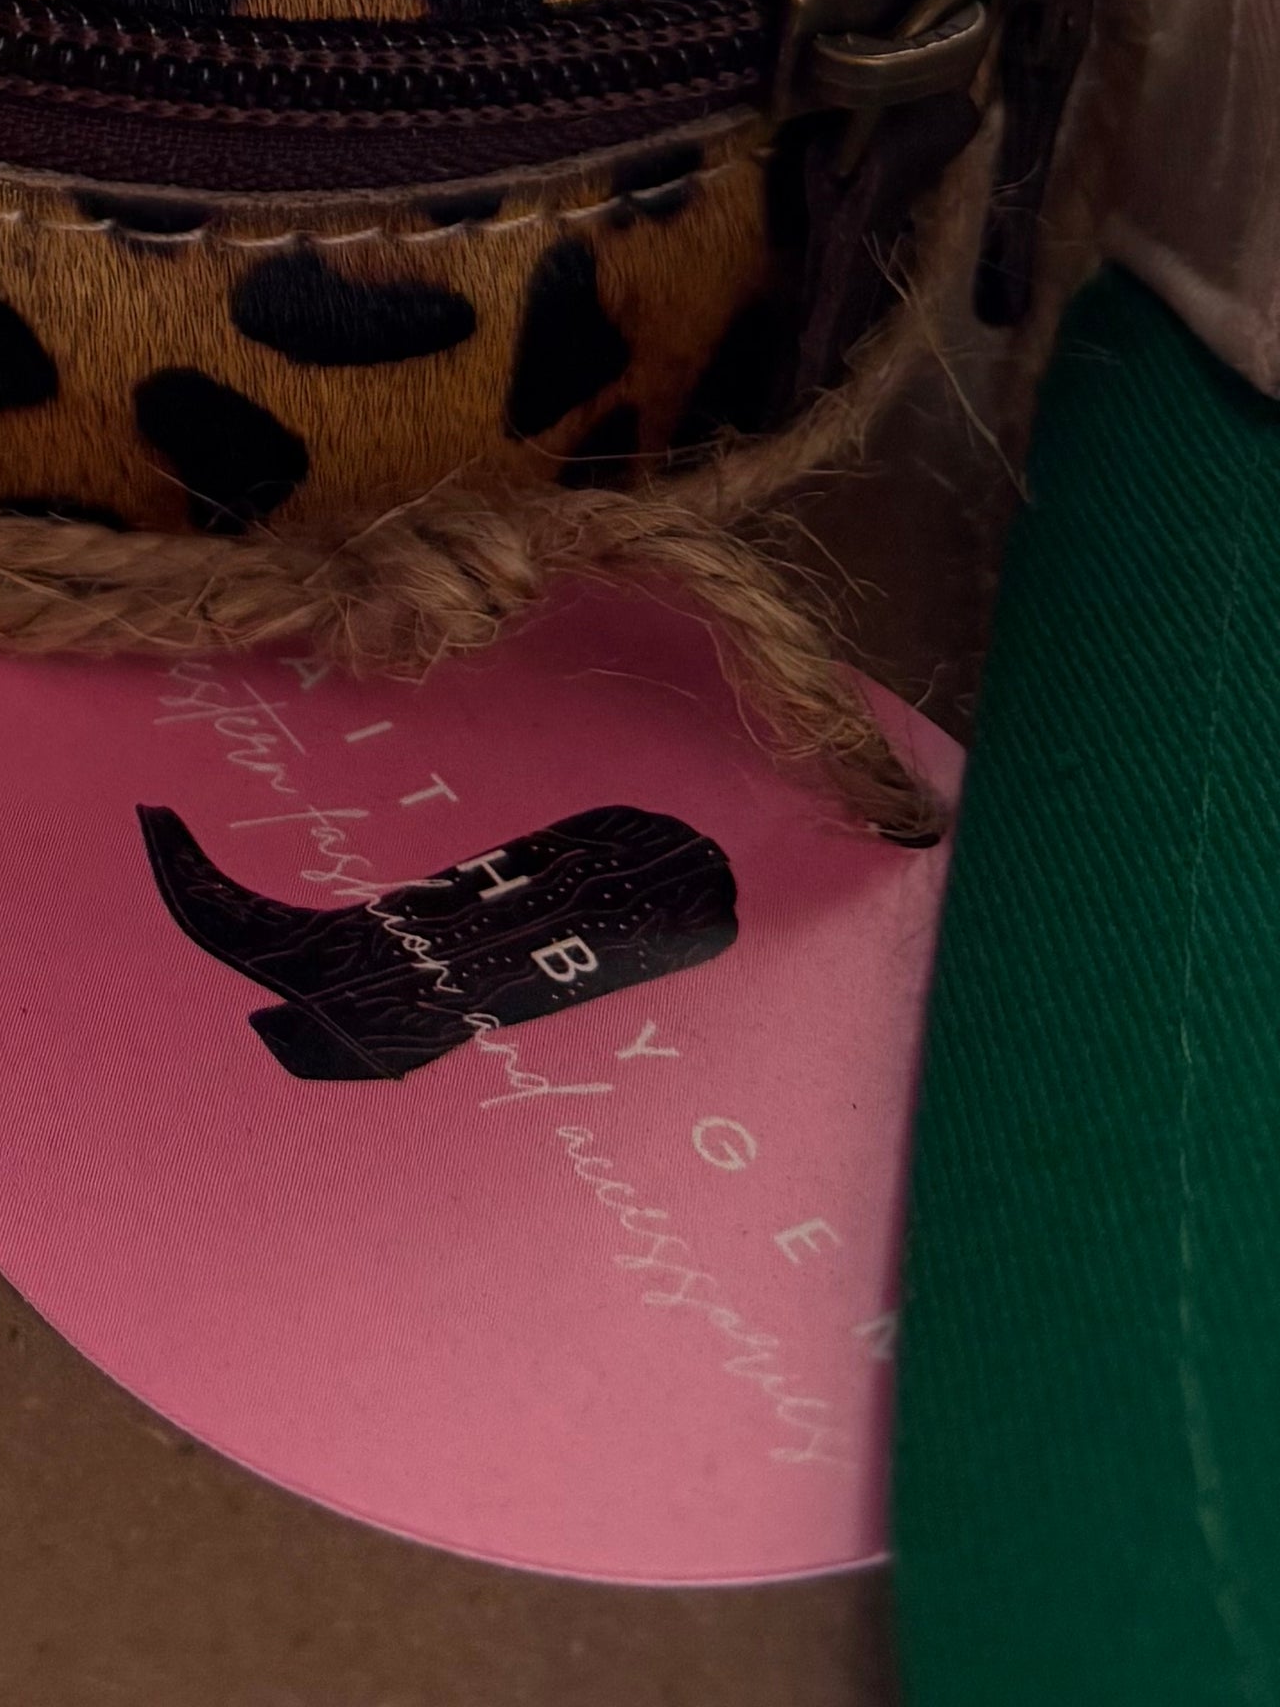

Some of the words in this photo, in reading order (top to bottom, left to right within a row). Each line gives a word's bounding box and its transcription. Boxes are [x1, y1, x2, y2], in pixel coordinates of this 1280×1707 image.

[151, 659, 308, 796] estern
[228, 804, 464, 995] fashion
[462, 1012, 613, 1109] and
[556, 1125, 854, 1468] accessories
